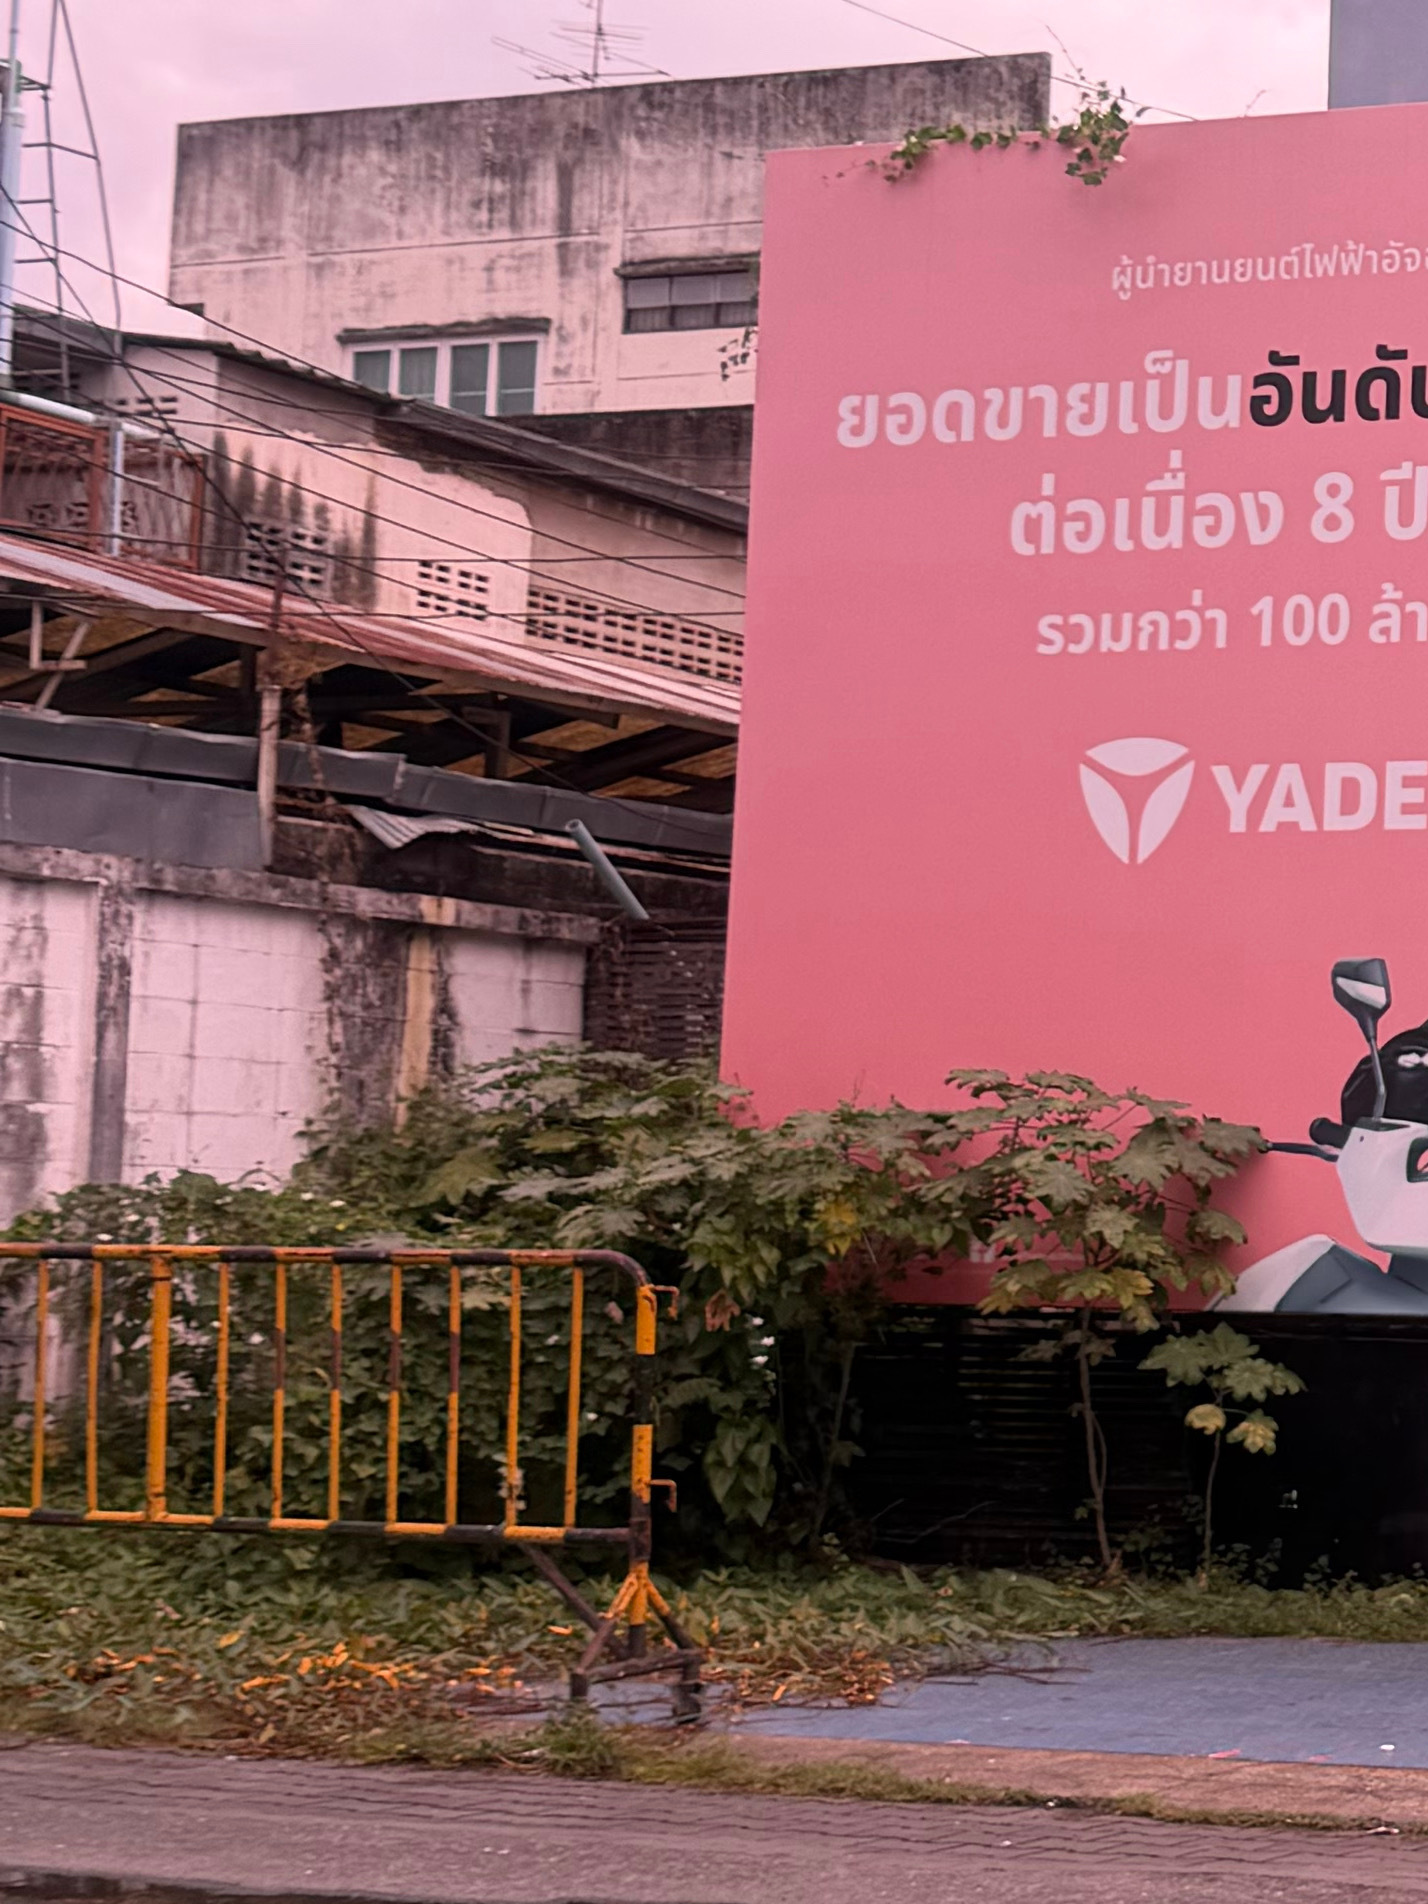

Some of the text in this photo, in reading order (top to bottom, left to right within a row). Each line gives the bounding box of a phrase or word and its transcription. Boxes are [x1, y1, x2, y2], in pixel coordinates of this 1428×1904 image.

[1009, 450, 1284, 556] ต่อเนื่อง
[1311, 471, 1355, 544] 8
[1035, 589, 1228, 656] รวมกว่า
[1250, 592, 1350, 647] 100
